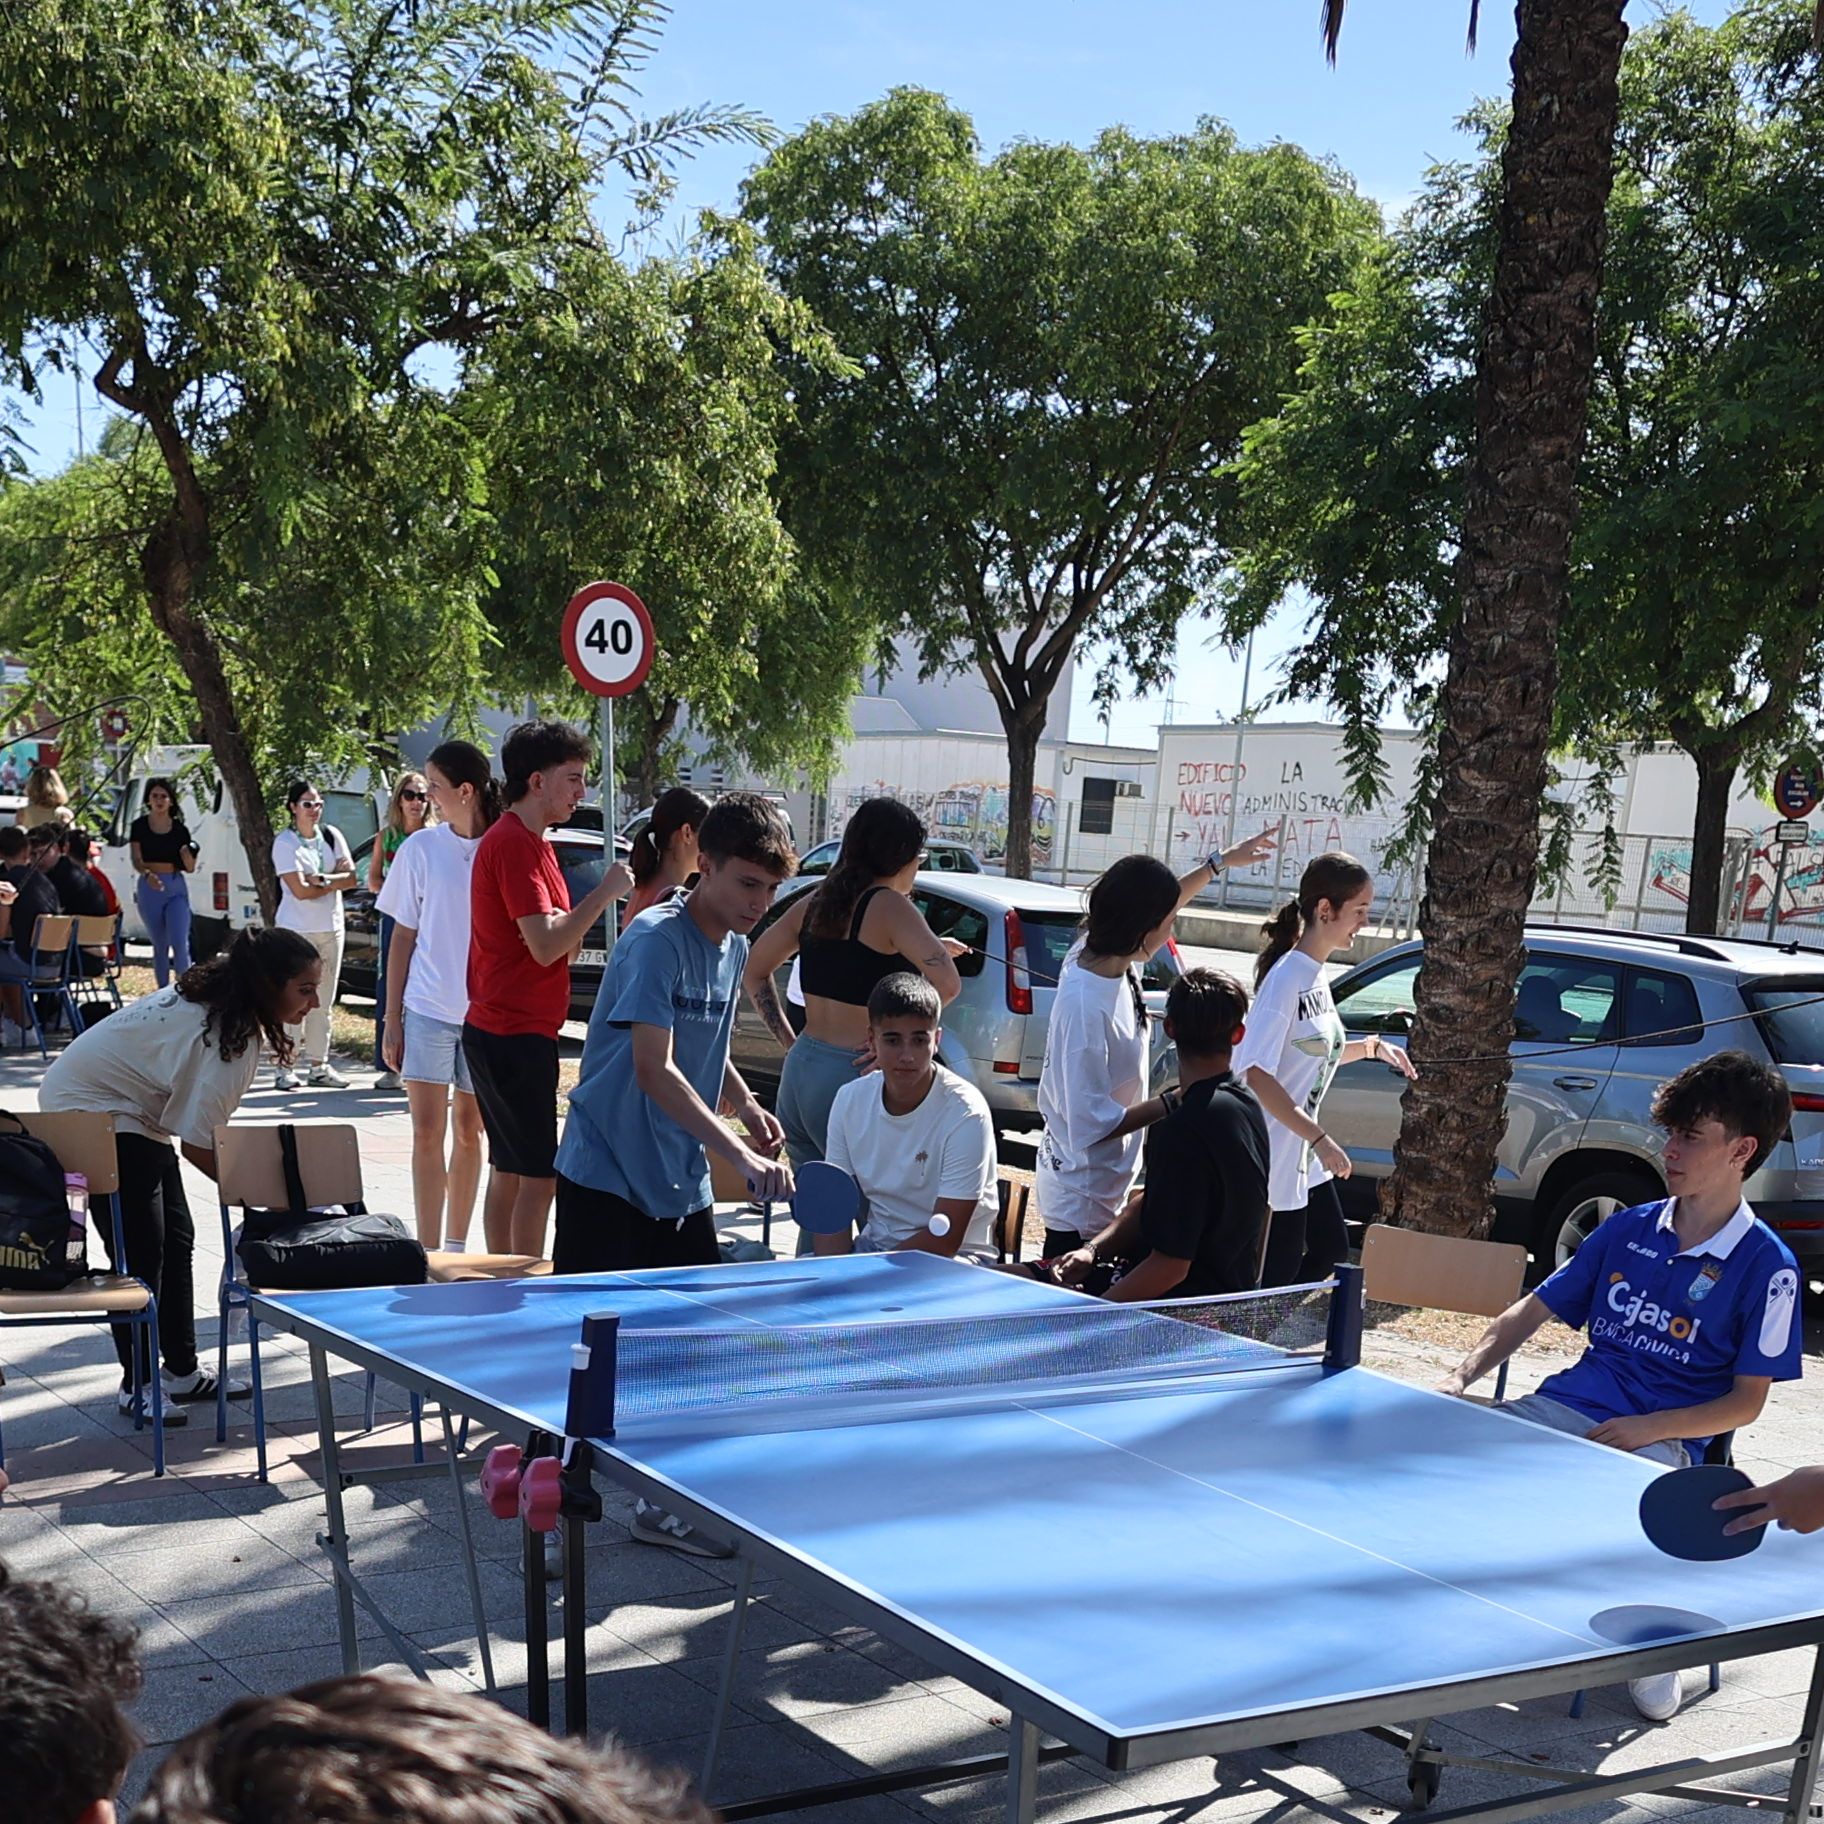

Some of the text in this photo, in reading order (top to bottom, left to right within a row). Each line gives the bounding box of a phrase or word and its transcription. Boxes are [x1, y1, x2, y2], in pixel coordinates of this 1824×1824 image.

[585, 619, 633, 655] 40
[1280, 761, 1303, 783] LA
[1607, 1281, 1702, 1345] Cajasol
